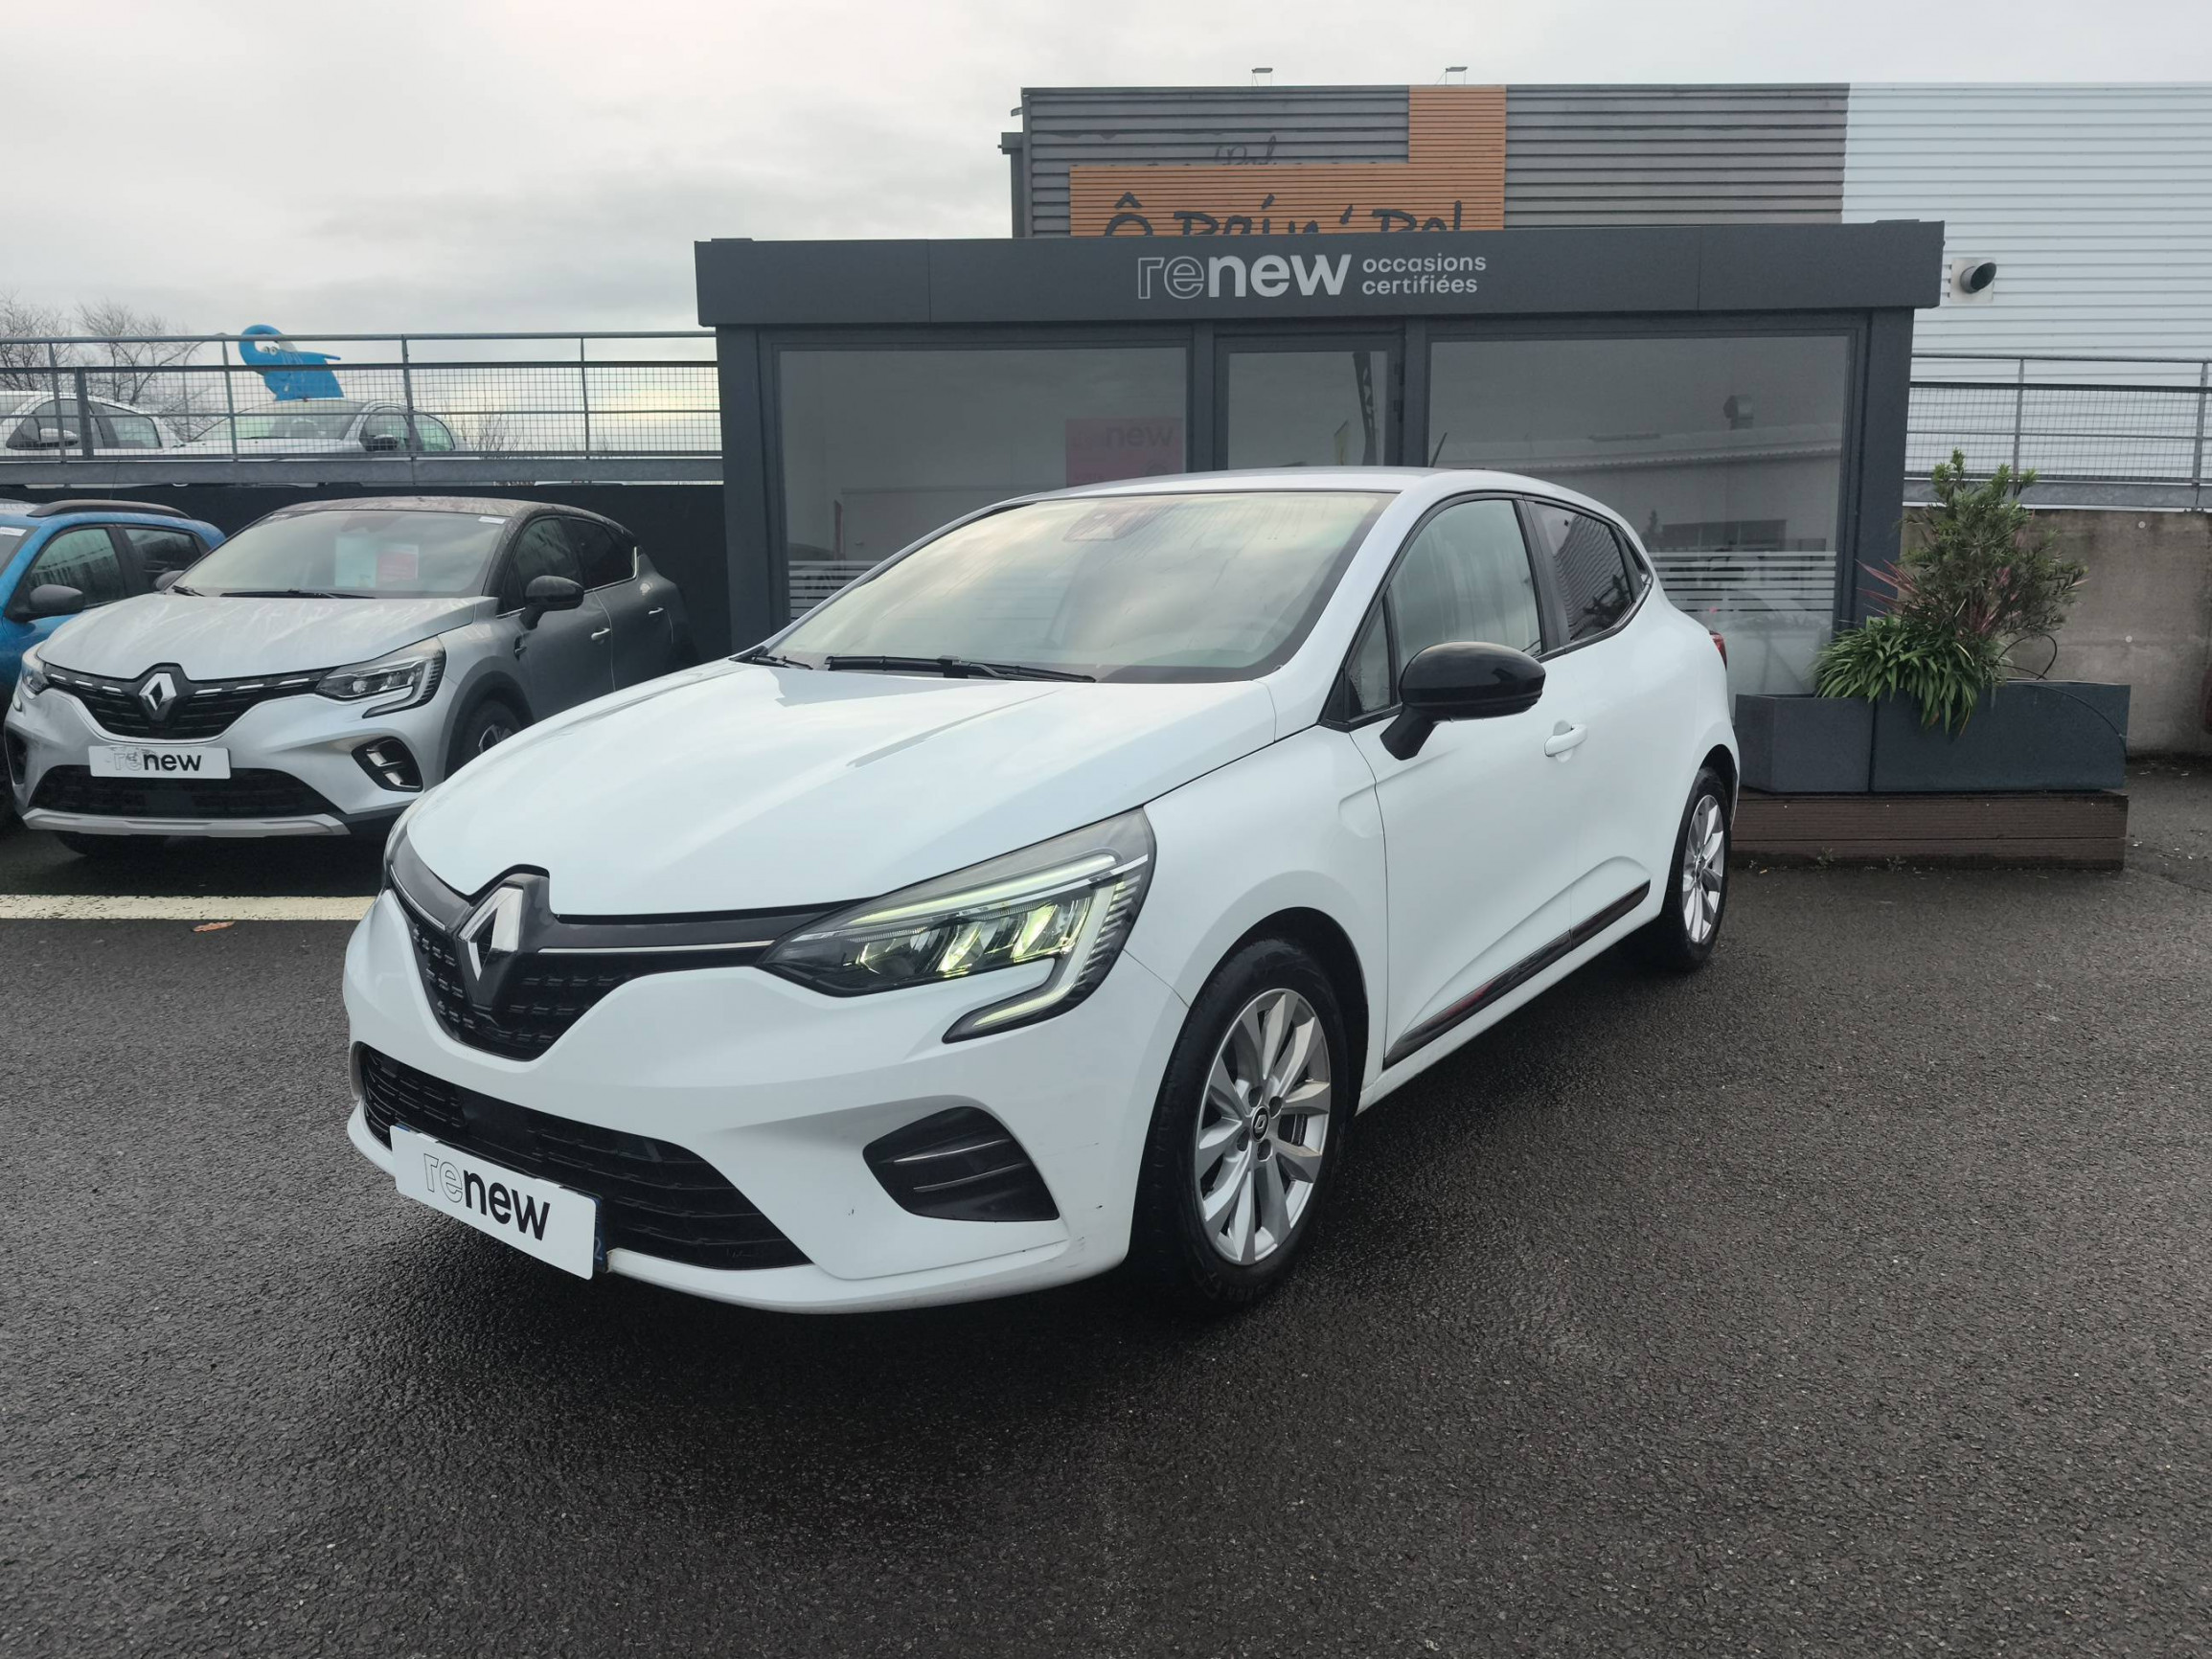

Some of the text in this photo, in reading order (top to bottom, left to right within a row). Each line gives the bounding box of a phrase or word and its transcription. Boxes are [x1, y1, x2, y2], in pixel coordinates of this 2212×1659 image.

[1362, 253, 1486, 273] occasions
[1138, 254, 1352, 299] renew
[1362, 274, 1477, 295] certifiées
[114, 753, 202, 771] renew
[423, 1153, 550, 1241] renew
